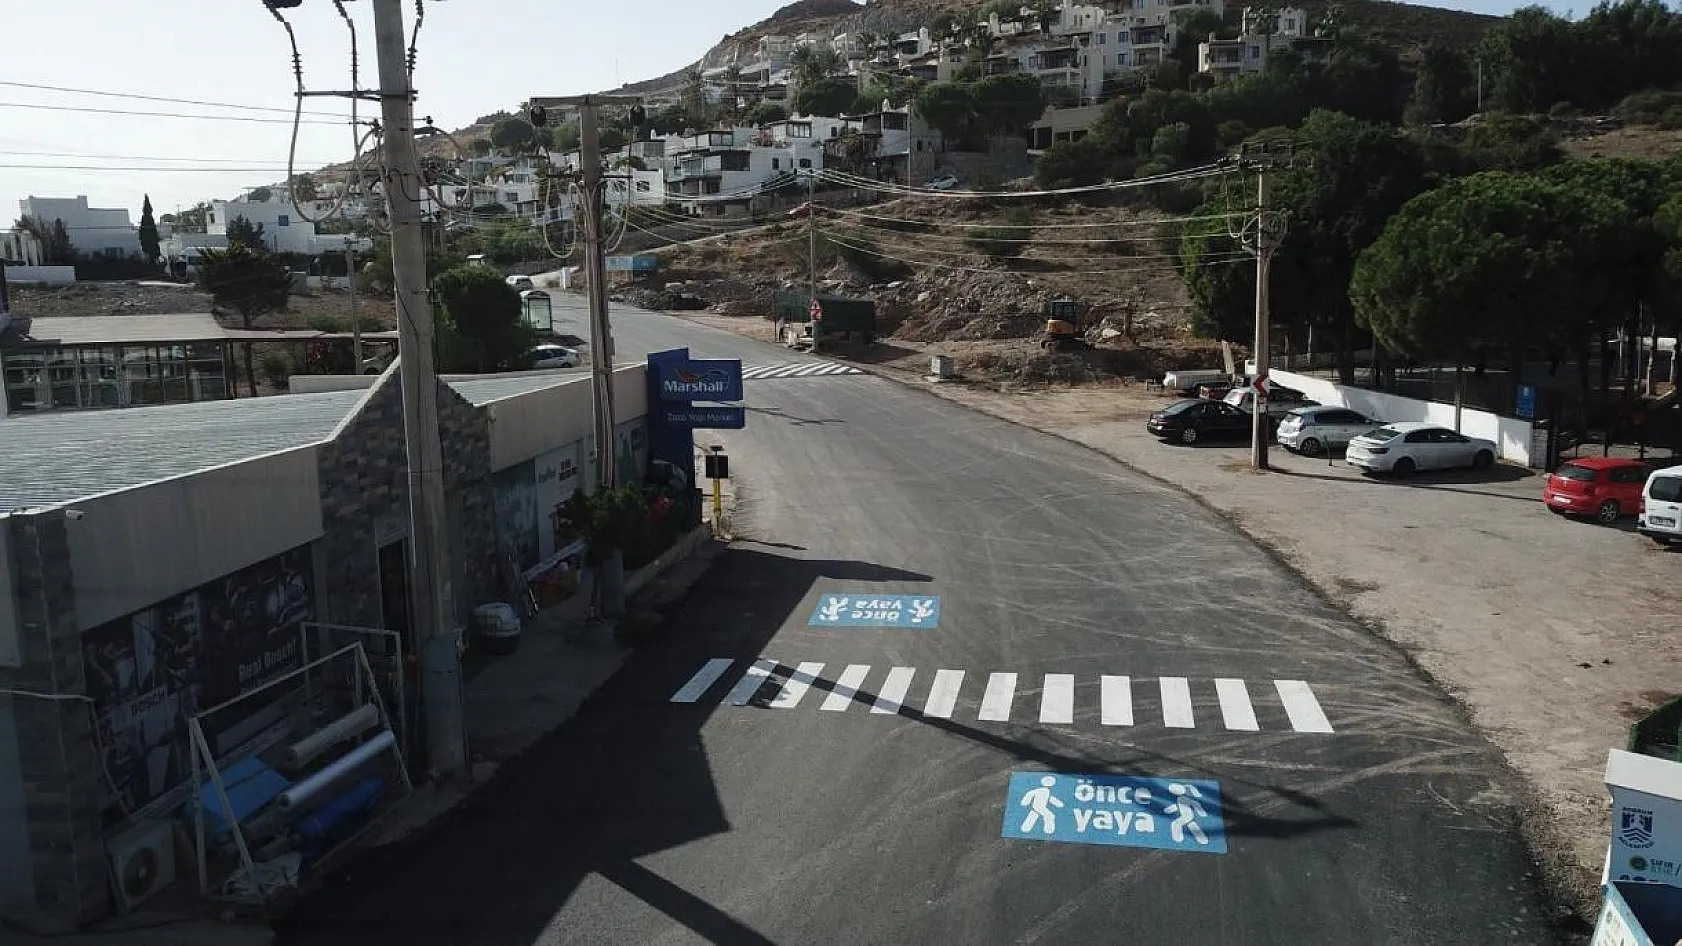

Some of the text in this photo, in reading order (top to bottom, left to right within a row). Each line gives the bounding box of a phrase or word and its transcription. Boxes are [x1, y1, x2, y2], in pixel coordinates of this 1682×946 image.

[663, 380, 724, 393] Marshall
[855, 599, 903, 610] yaya
[851, 610, 901, 622] önce
[1073, 778, 1152, 805] önce
[1073, 807, 1155, 835] yaya
